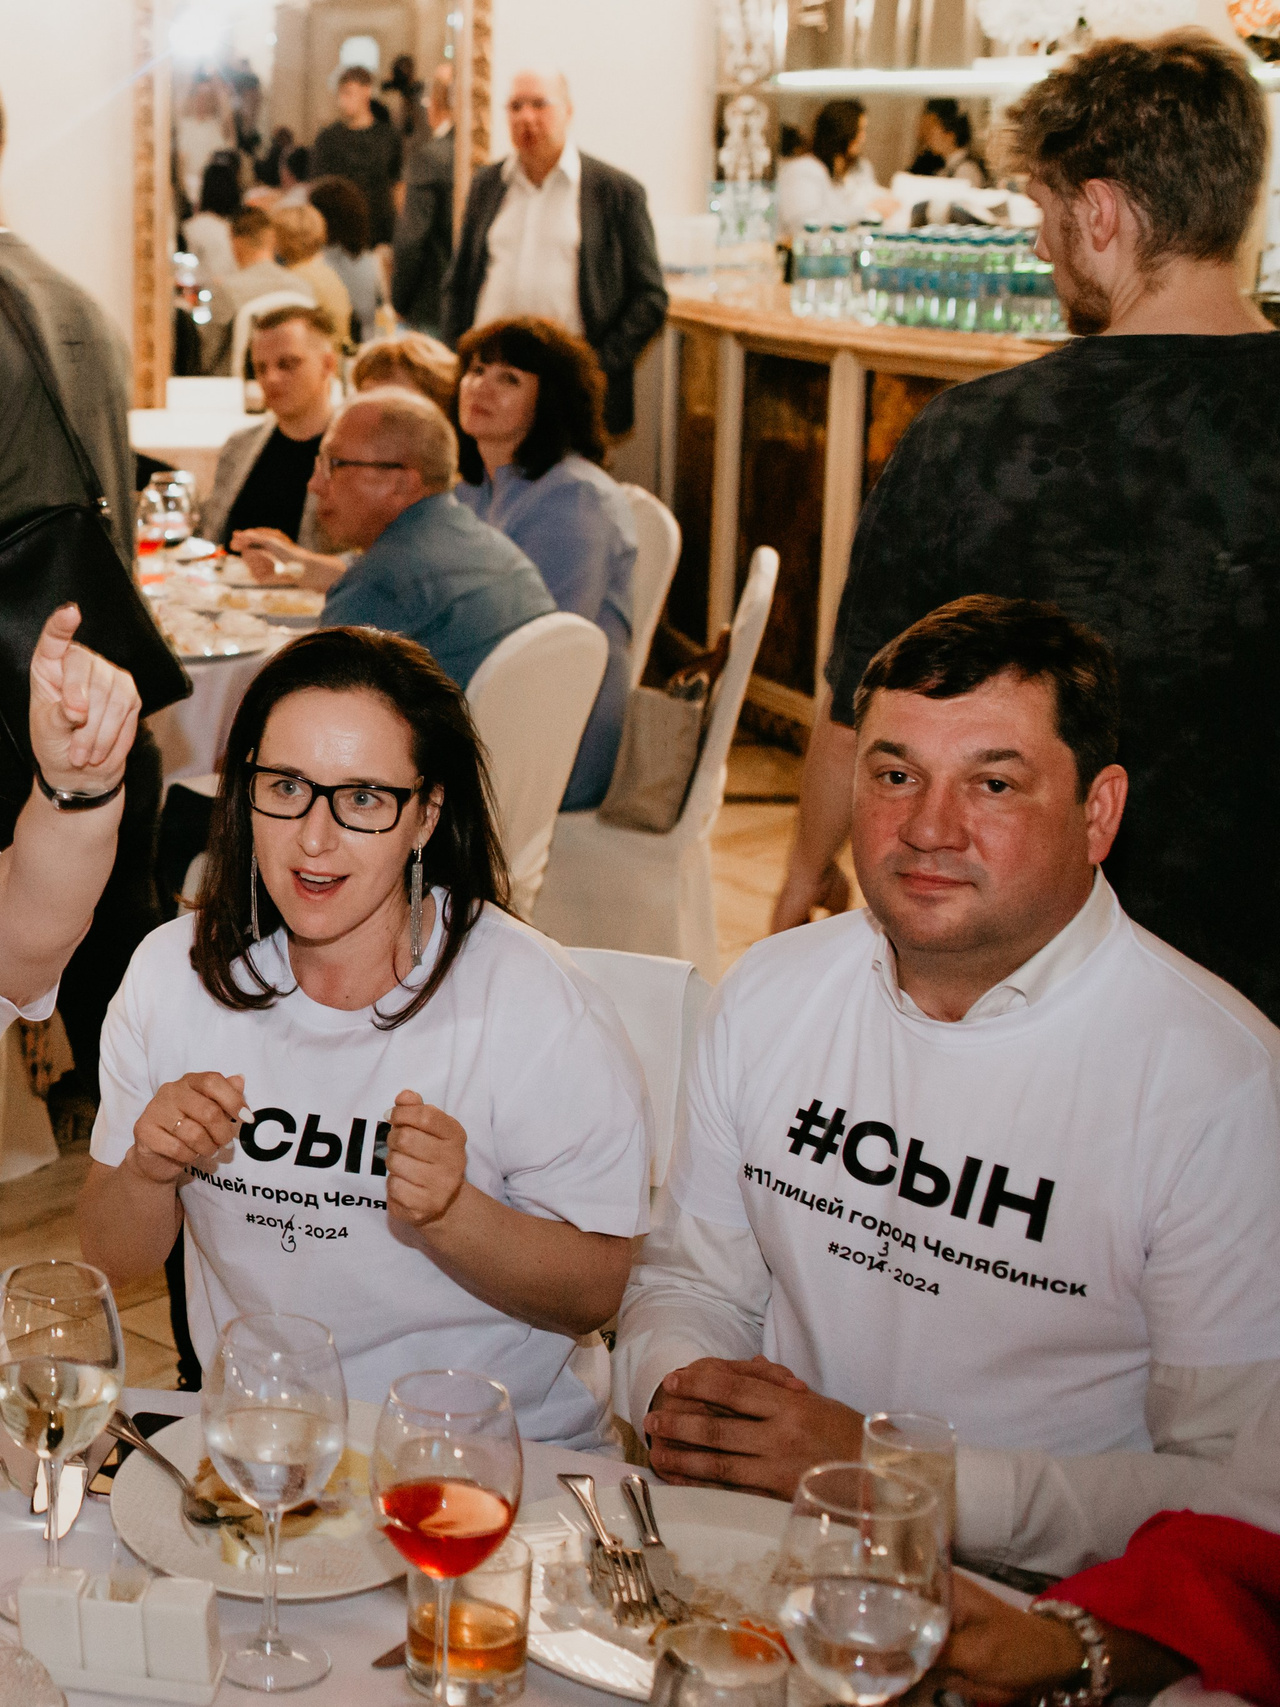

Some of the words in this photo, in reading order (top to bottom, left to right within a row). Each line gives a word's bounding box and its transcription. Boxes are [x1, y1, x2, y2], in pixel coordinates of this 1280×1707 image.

[786, 1099, 1055, 1243] #СЫН
[252, 1186, 319, 1209] город
[324, 1191, 387, 1210] Челя
[305, 1224, 348, 1239] 2024
[848, 1210, 916, 1252] город
[923, 1235, 1087, 1297] Челябинск
[893, 1268, 939, 1296] 2024
